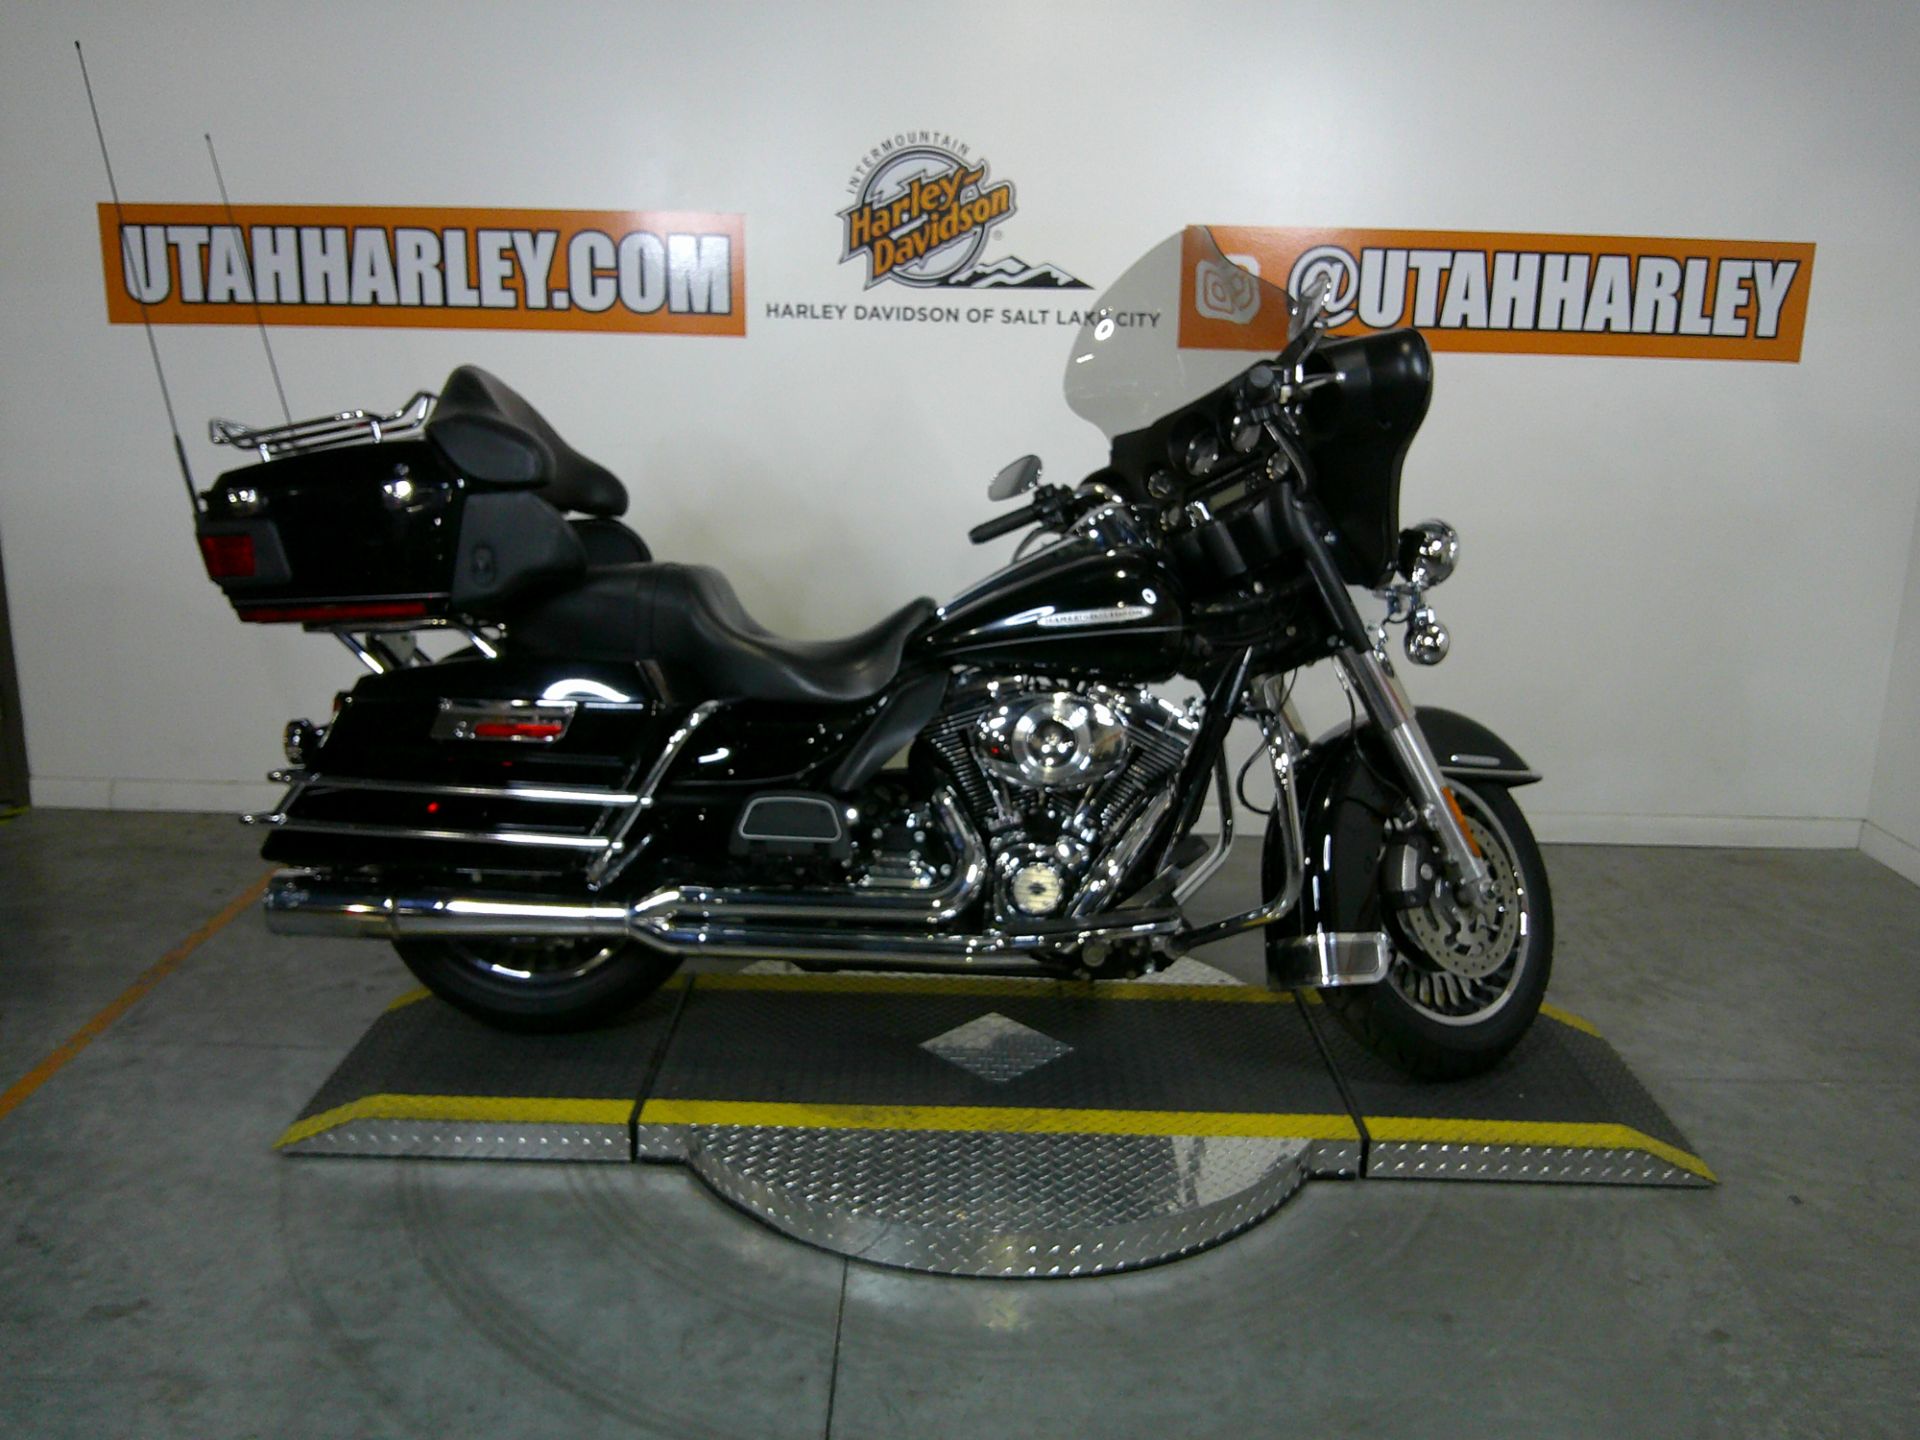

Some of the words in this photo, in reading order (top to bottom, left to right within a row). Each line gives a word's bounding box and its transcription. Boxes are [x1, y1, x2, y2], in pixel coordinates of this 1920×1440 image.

[846, 131, 971, 194] INTERMOUNTAIN
[119, 223, 732, 315] UTAHHARLEY.COM
[872, 184, 1011, 277] Davidson
[765, 303, 847, 320] HARLEY
[854, 305, 959, 323] DAVIDSON
[966, 307, 993, 324] OF
[1000, 308, 1048, 325] SALT
[1115, 312, 1161, 327] CITY
[1287, 245, 1801, 339] @UTAHHARLEY
